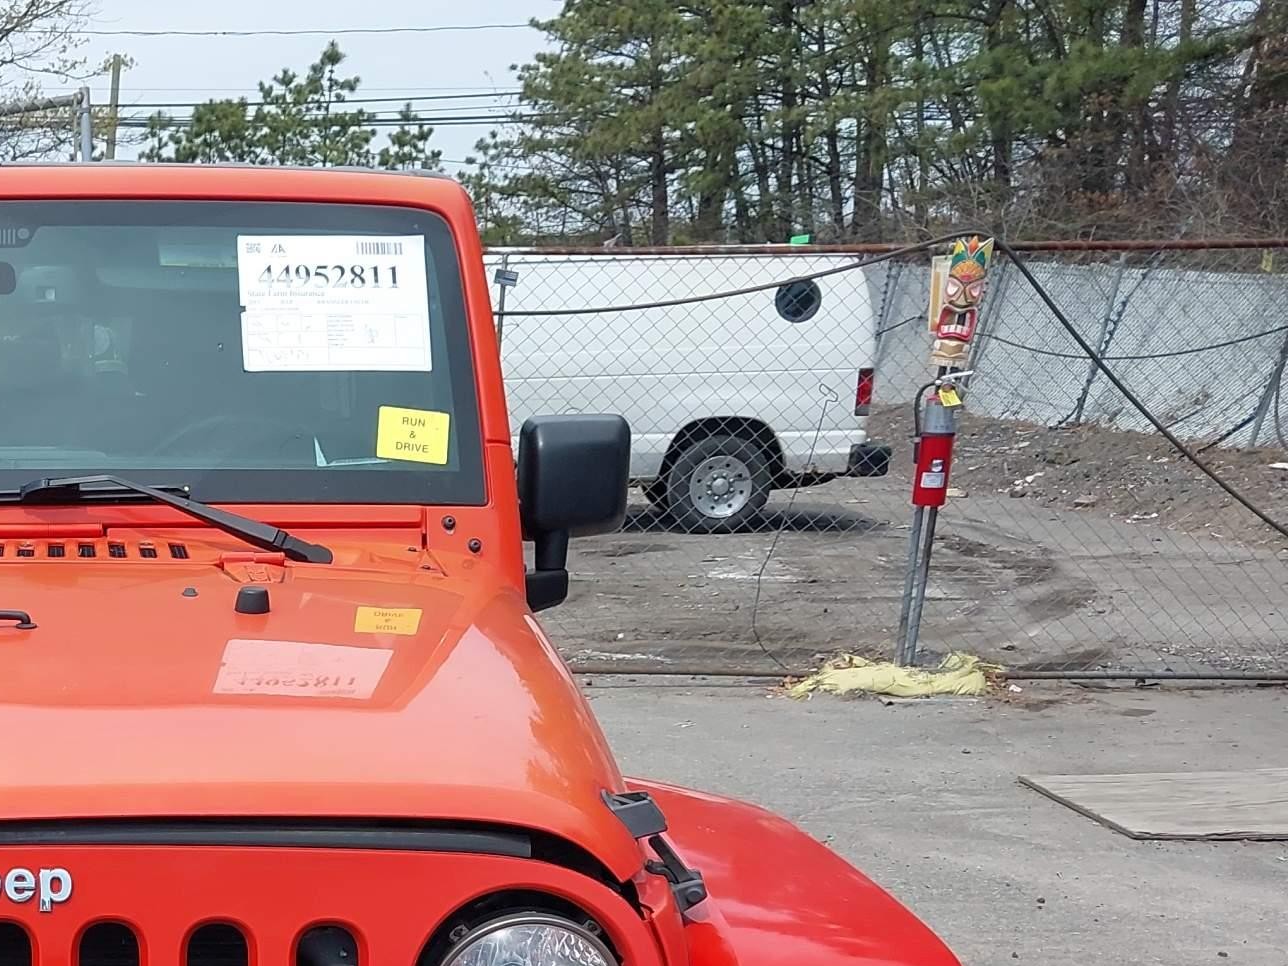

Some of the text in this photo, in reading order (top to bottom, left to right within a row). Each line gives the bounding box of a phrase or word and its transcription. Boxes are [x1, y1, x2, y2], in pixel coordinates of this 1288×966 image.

[258, 264, 399, 288] 44952811
[402, 416, 426, 427] RUN
[409, 431, 416, 439] &
[395, 441, 429, 454] DRIVE
